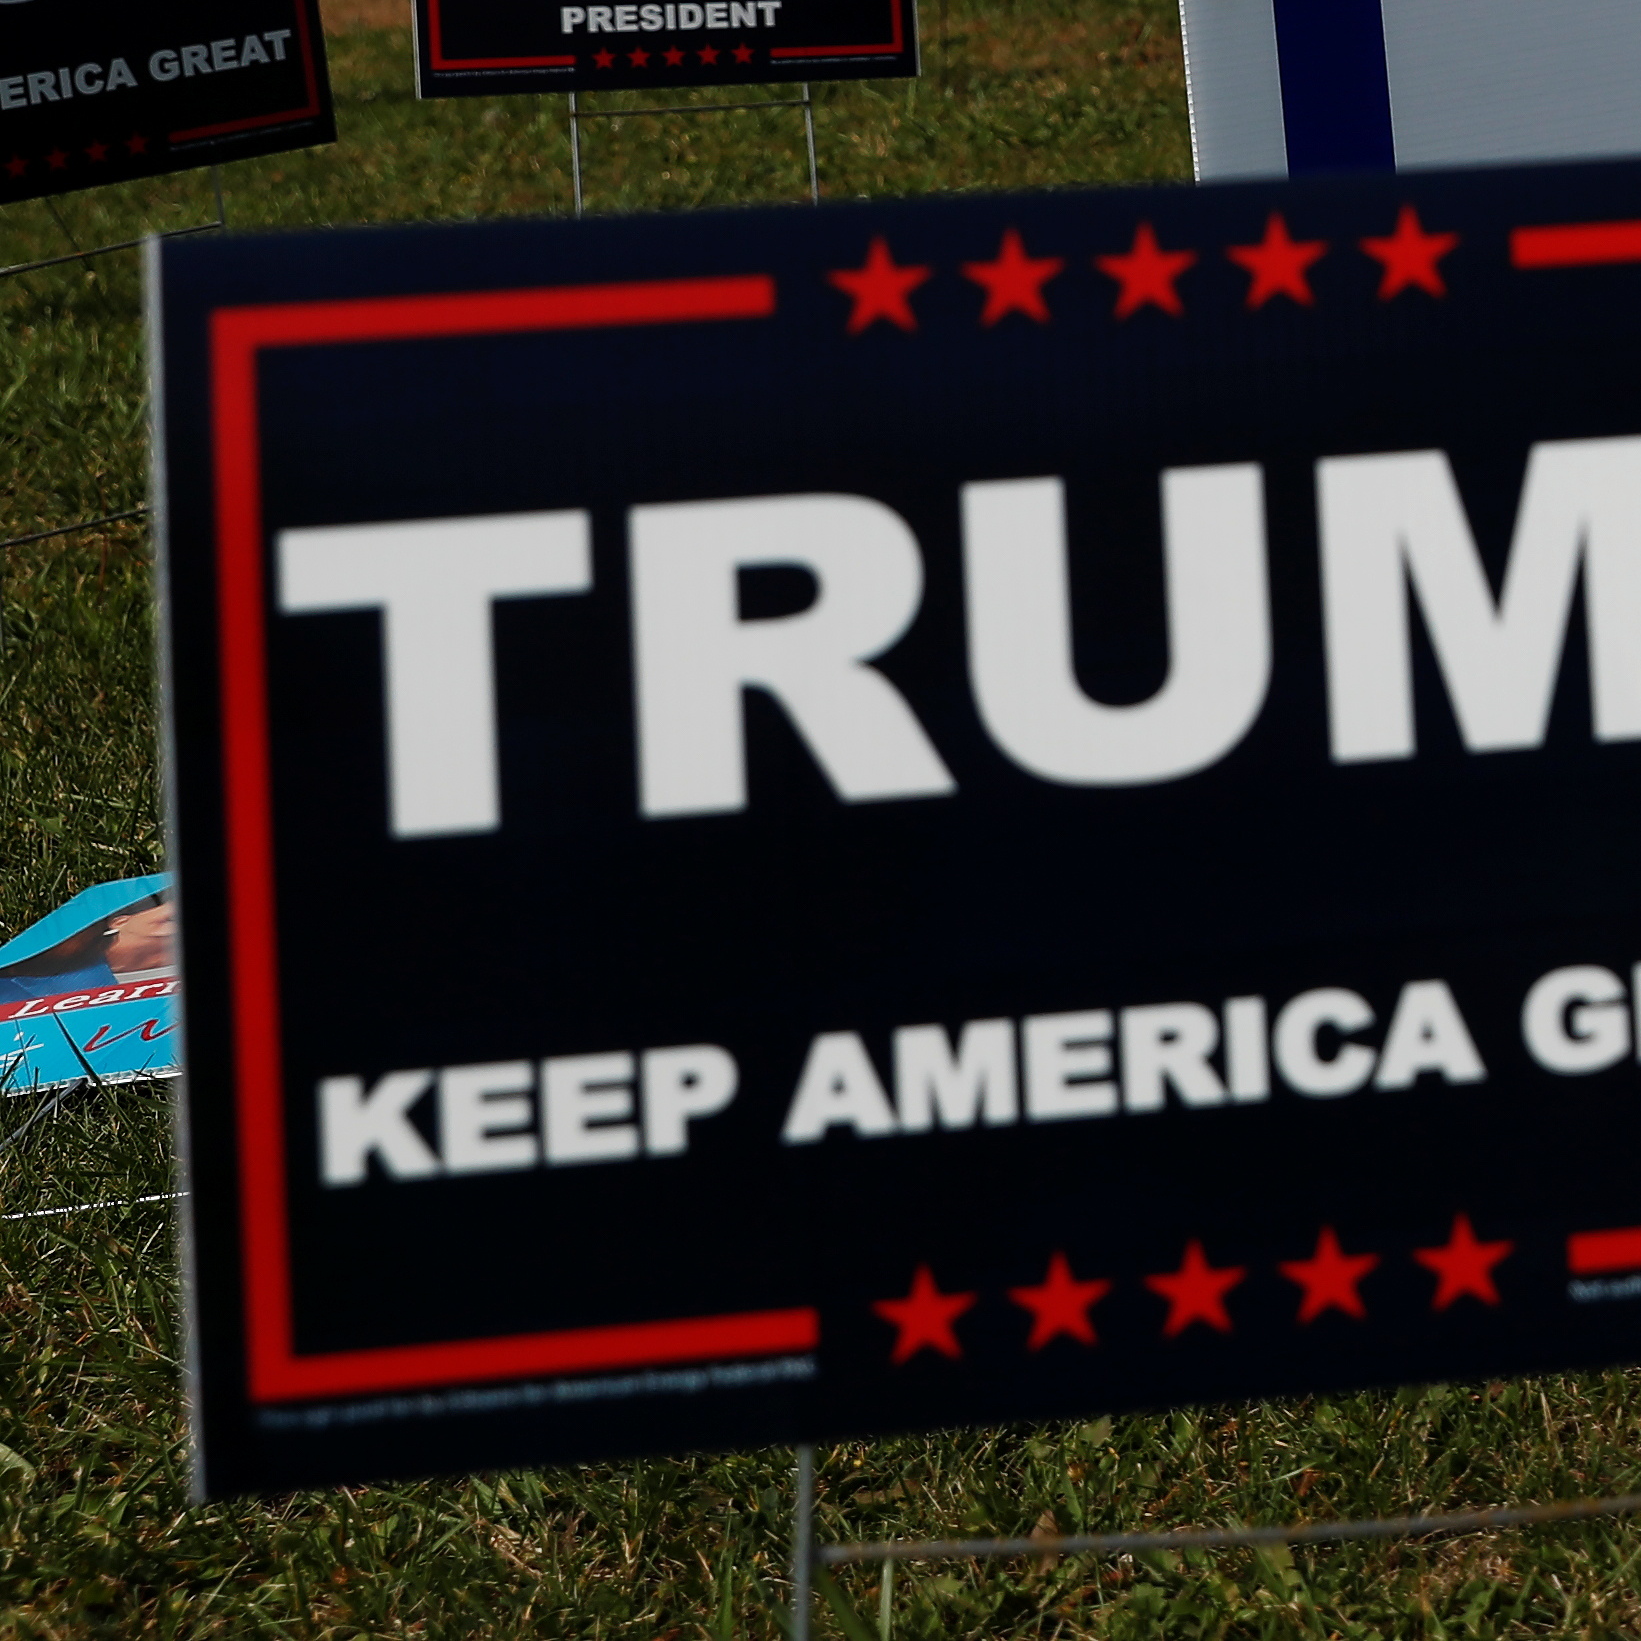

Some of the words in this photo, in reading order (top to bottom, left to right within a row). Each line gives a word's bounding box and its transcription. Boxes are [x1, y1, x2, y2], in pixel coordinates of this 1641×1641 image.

[560, 0, 782, 34] PRESIDENT
[148, 28, 292, 83] GREAT
[317, 1044, 740, 1187] KEEP
[783, 980, 1485, 1145] AMERICA
